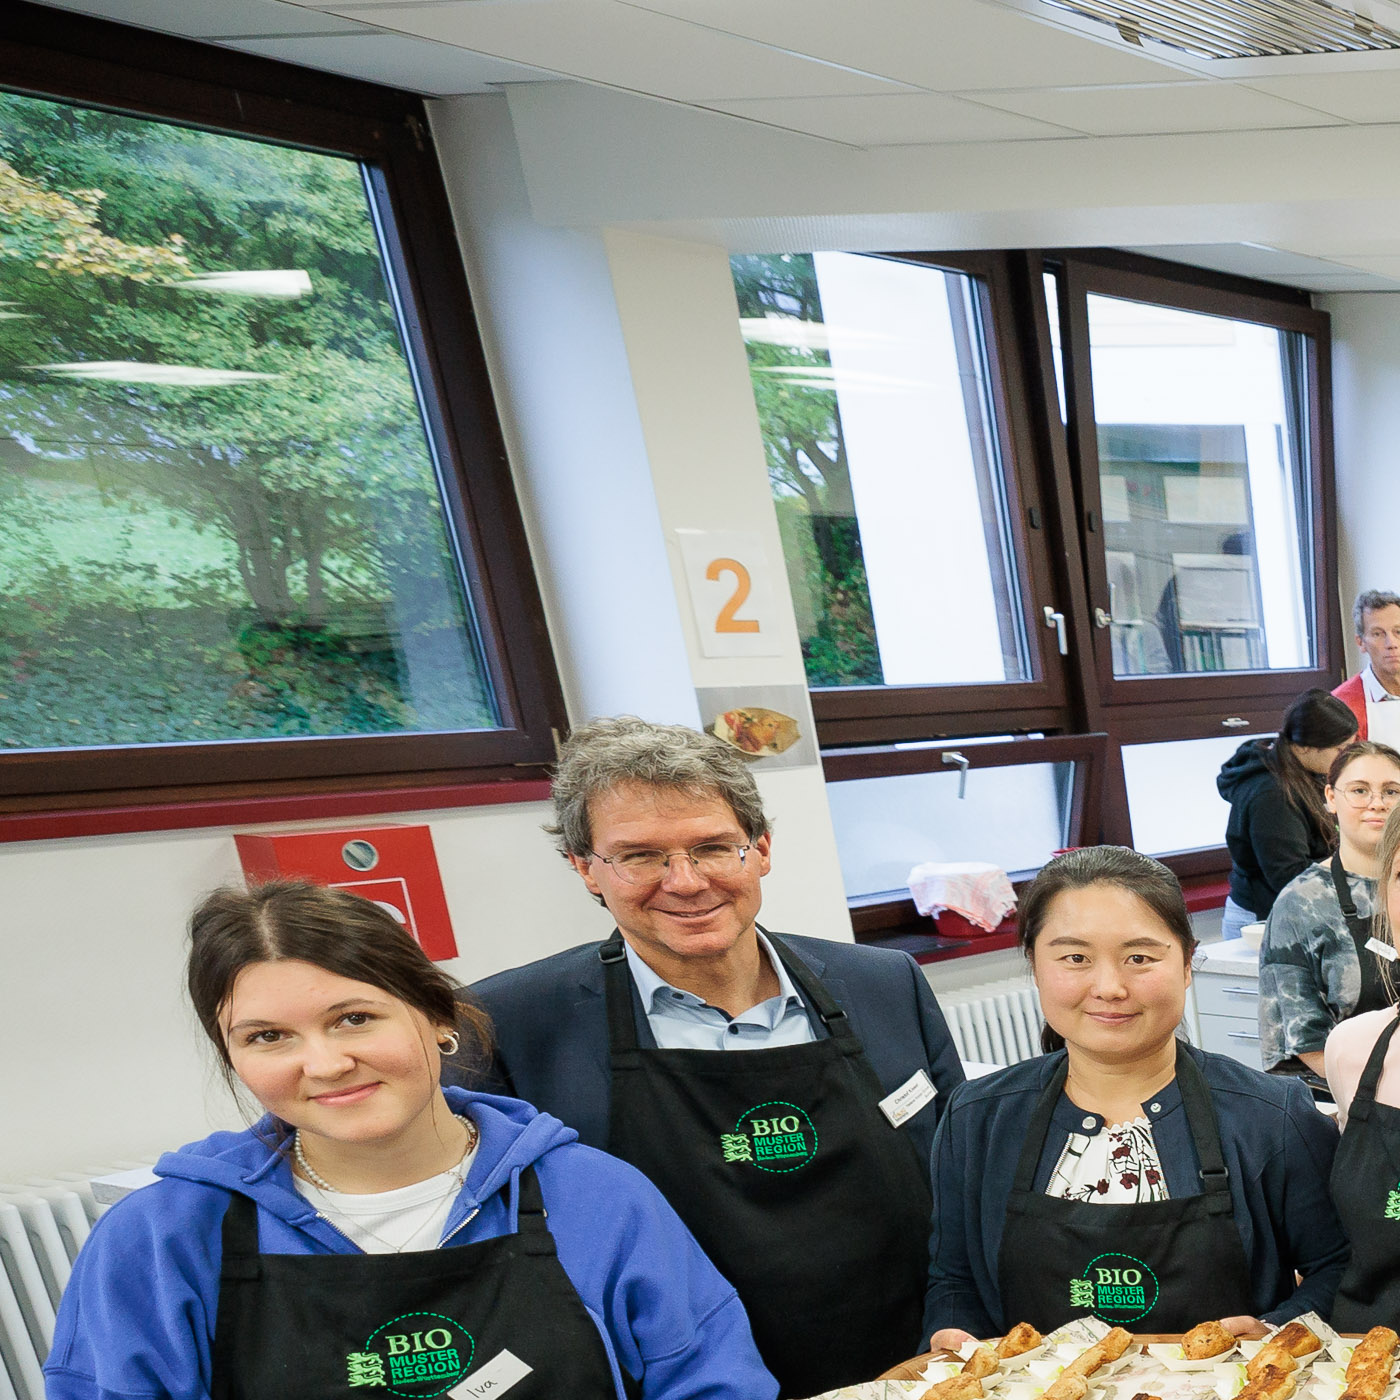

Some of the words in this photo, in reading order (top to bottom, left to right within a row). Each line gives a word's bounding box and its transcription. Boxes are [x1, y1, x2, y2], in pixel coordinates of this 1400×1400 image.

[705, 557, 760, 633] 2
[750, 1115, 799, 1136] BIO
[754, 1132, 804, 1146] MUSTER
[756, 1142, 806, 1155] REGION
[1095, 1268, 1142, 1285] BIO
[1097, 1286, 1144, 1295] MUSTER
[1098, 1295, 1145, 1304] REGION
[385, 1328, 452, 1355] BIO
[389, 1348, 459, 1368] MUSTER
[391, 1359, 461, 1379] REGION
[466, 1380, 498, 1399] Iva
